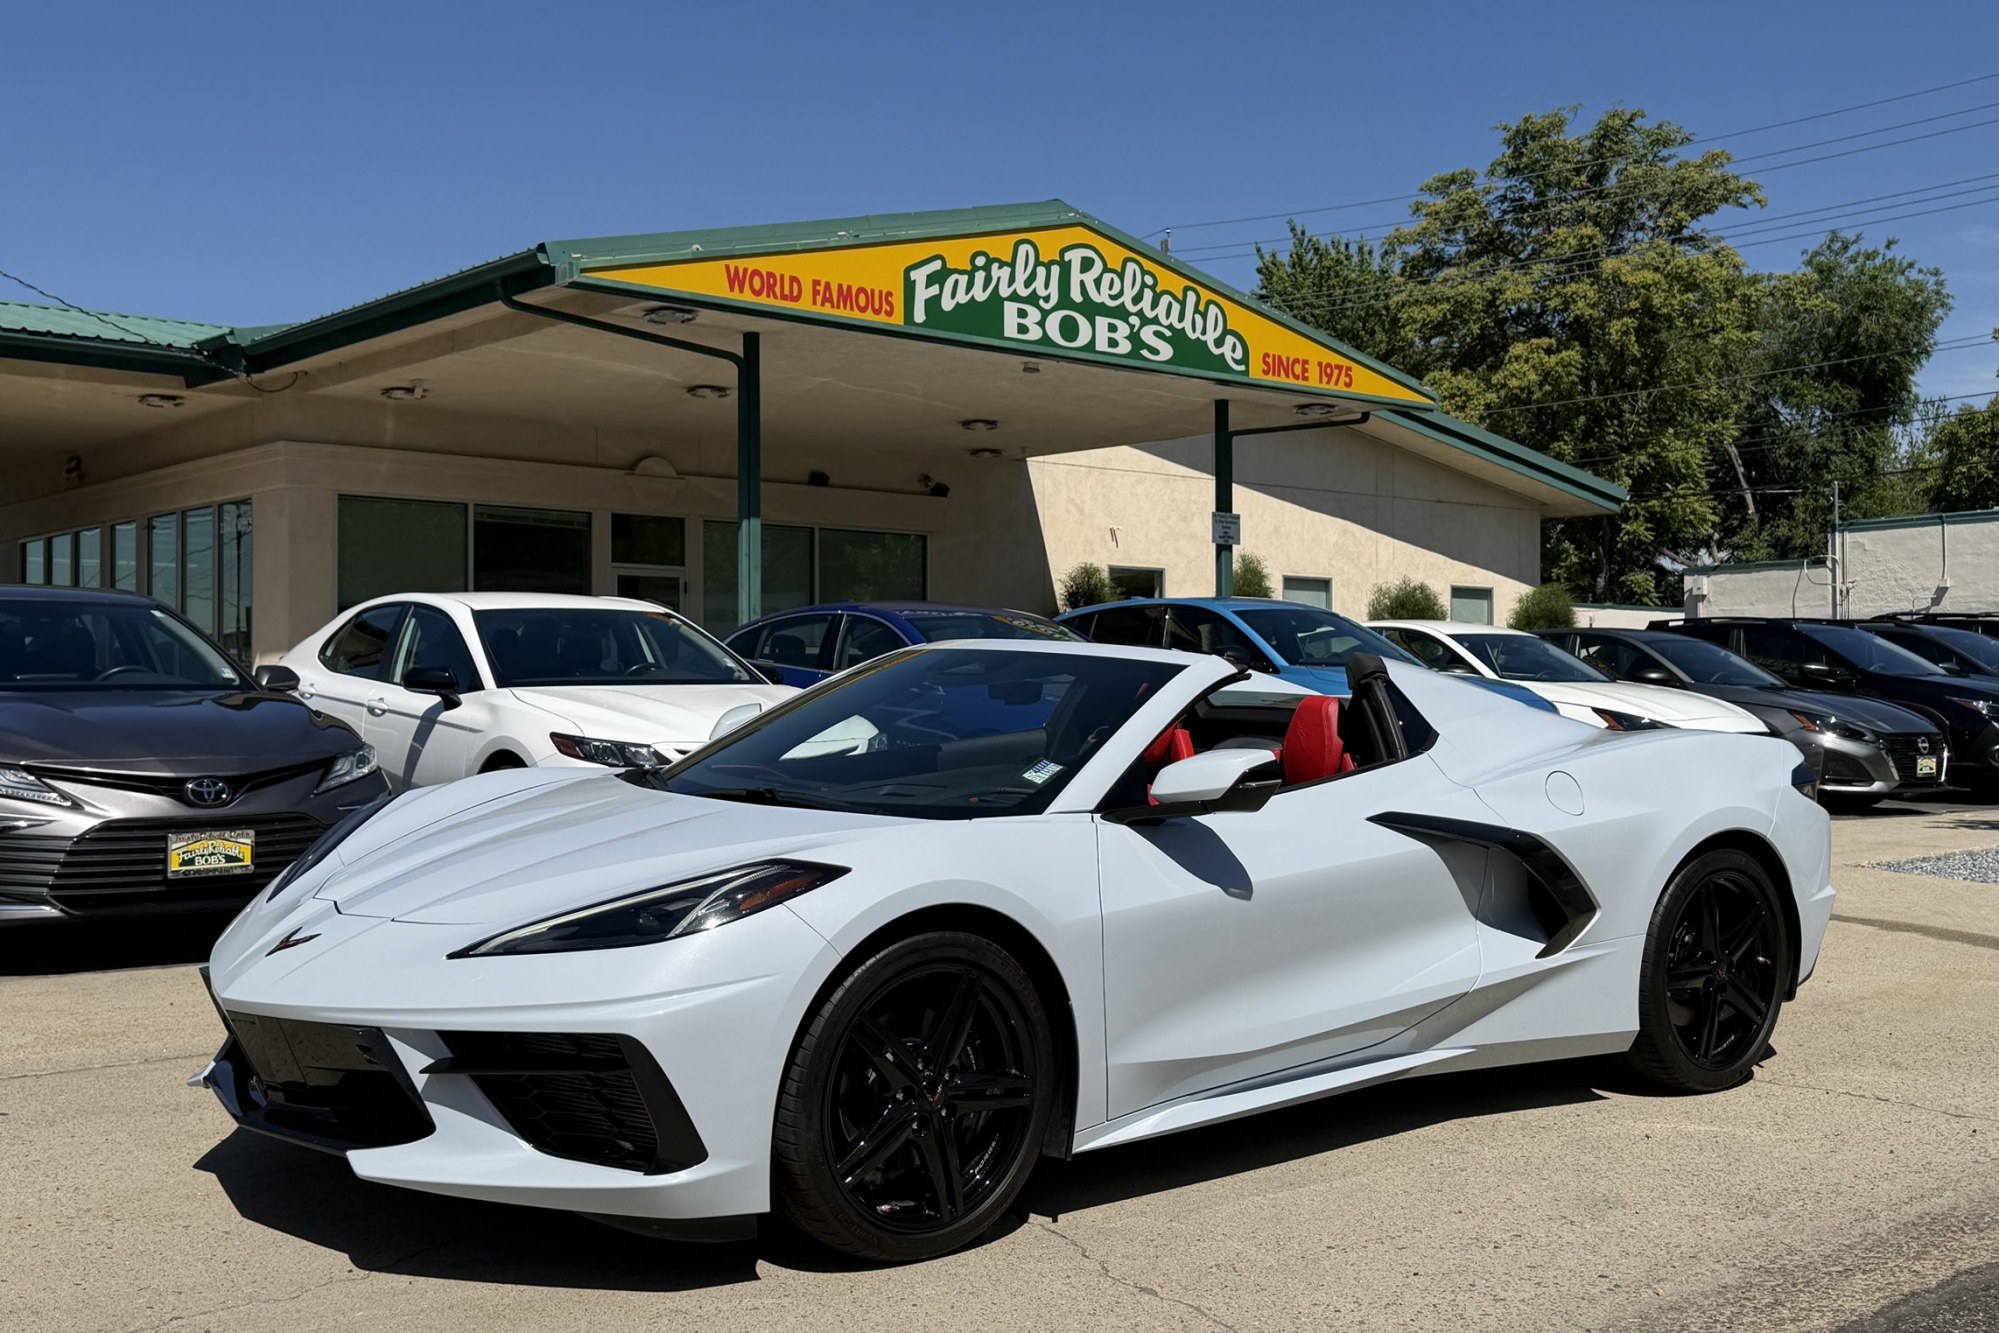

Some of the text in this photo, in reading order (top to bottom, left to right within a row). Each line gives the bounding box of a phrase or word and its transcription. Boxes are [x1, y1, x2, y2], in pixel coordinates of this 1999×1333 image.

[724, 263, 895, 318] WORLD FAMOUS
[909, 243, 1246, 371] Fairly Reliable
[1003, 300, 1174, 362] BOB'S
[1261, 352, 1353, 388] SINCE 1975
[194, 853, 226, 866] BOB'S
